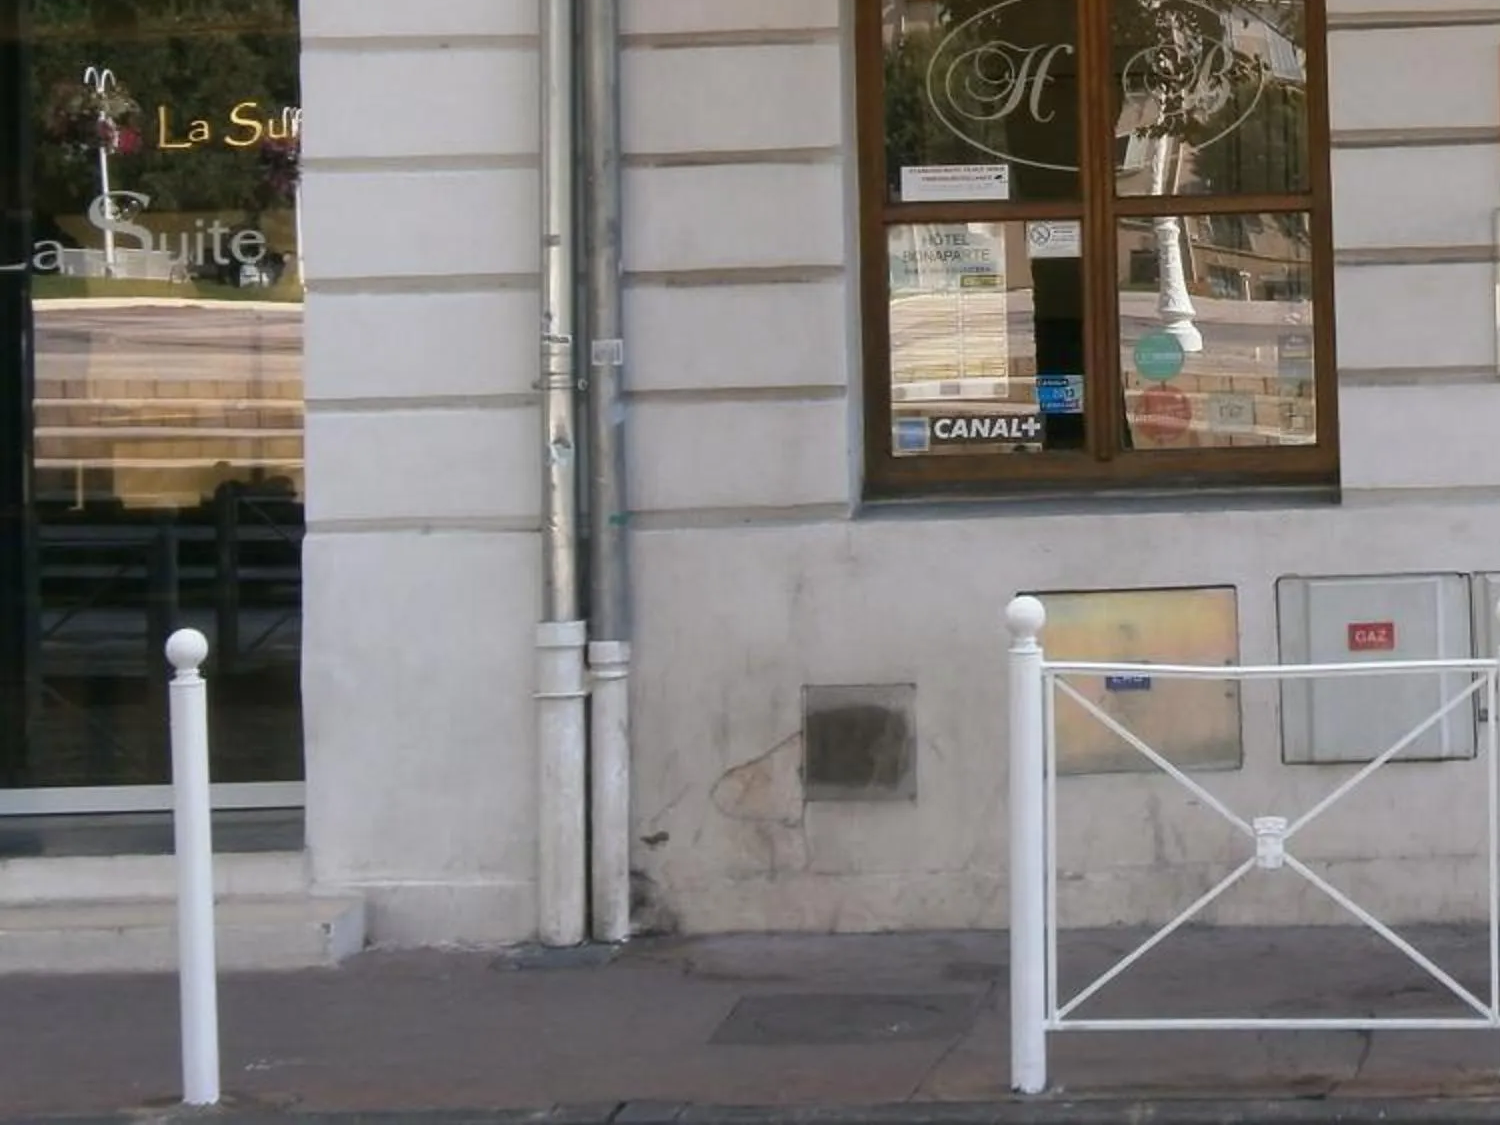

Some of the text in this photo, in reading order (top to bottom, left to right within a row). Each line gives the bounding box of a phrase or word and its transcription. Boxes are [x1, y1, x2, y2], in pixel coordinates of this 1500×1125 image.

[158, 105, 209, 148] La
[88, 190, 267, 278] Suite
[934, 416, 1041, 439] CANAL+
[1355, 629, 1388, 643] GAZ
